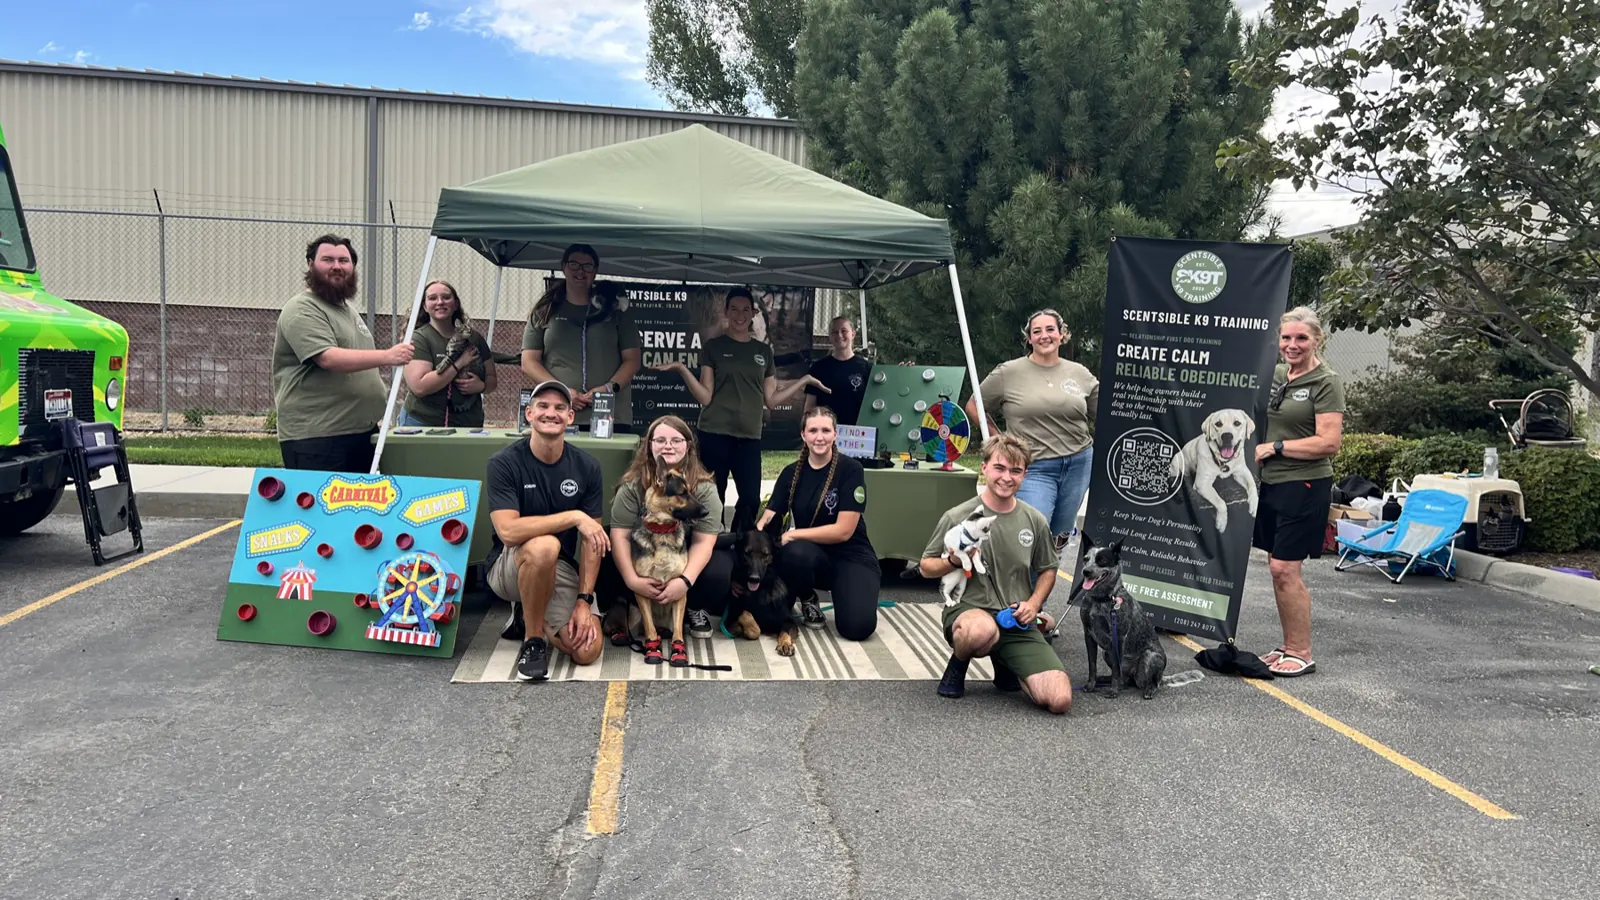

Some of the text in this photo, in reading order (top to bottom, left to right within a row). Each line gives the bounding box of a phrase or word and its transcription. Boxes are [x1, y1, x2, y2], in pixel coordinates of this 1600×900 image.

[1176, 252, 1224, 269] SCENTSIBLE
[674, 292, 688, 301] K9
[1175, 284, 1222, 302] K9 TRAINING
[1123, 309, 1269, 330] SCENTSIBLE K9 TRAINING
[691, 332, 702, 349] A
[1129, 333, 1165, 341] RELATIONSHIP
[1196, 338, 1222, 346] TRAINING
[642, 351, 673, 368] CAN
[1117, 343, 1210, 365] CREATE CALM
[1116, 362, 1260, 390] RELIABLE OBEDIENCE.
[1114, 382, 1125, 390] We
[1126, 383, 1141, 394] help
[1142, 385, 1154, 395] dog
[1155, 388, 1180, 397] owners
[1180, 389, 1201, 398] build
[1112, 391, 1204, 408] real relationship with their
[1112, 400, 1124, 409] dog
[1134, 402, 1145, 410] the
[1146, 405, 1167, 414] results
[1110, 410, 1153, 420] actually last.
[839, 428, 860, 436] FIND
[844, 440, 859, 448] THE
[329, 485, 388, 505] CARNIVAL
[414, 497, 460, 518] GAMES
[1113, 510, 1202, 534] Keep Your Dog's Personality
[253, 529, 300, 550] SNACKS
[1111, 526, 1197, 548] Build Long Lasting Results
[1130, 547, 1149, 556] Calm,
[1150, 550, 1177, 561] Reliable
[1177, 556, 1207, 567] Behavior
[1140, 564, 1155, 572] GROUP
[1156, 566, 1176, 577] CLASSES
[1183, 572, 1194, 580] REAL
[1196, 575, 1212, 584] WORLD
[1212, 578, 1234, 589] TRAINING
[1140, 586, 1160, 598] FREE
[1160, 591, 1214, 610] ASSESSMENT
[1174, 617, 1189, 626] (208)
[1190, 621, 1200, 629] 247
